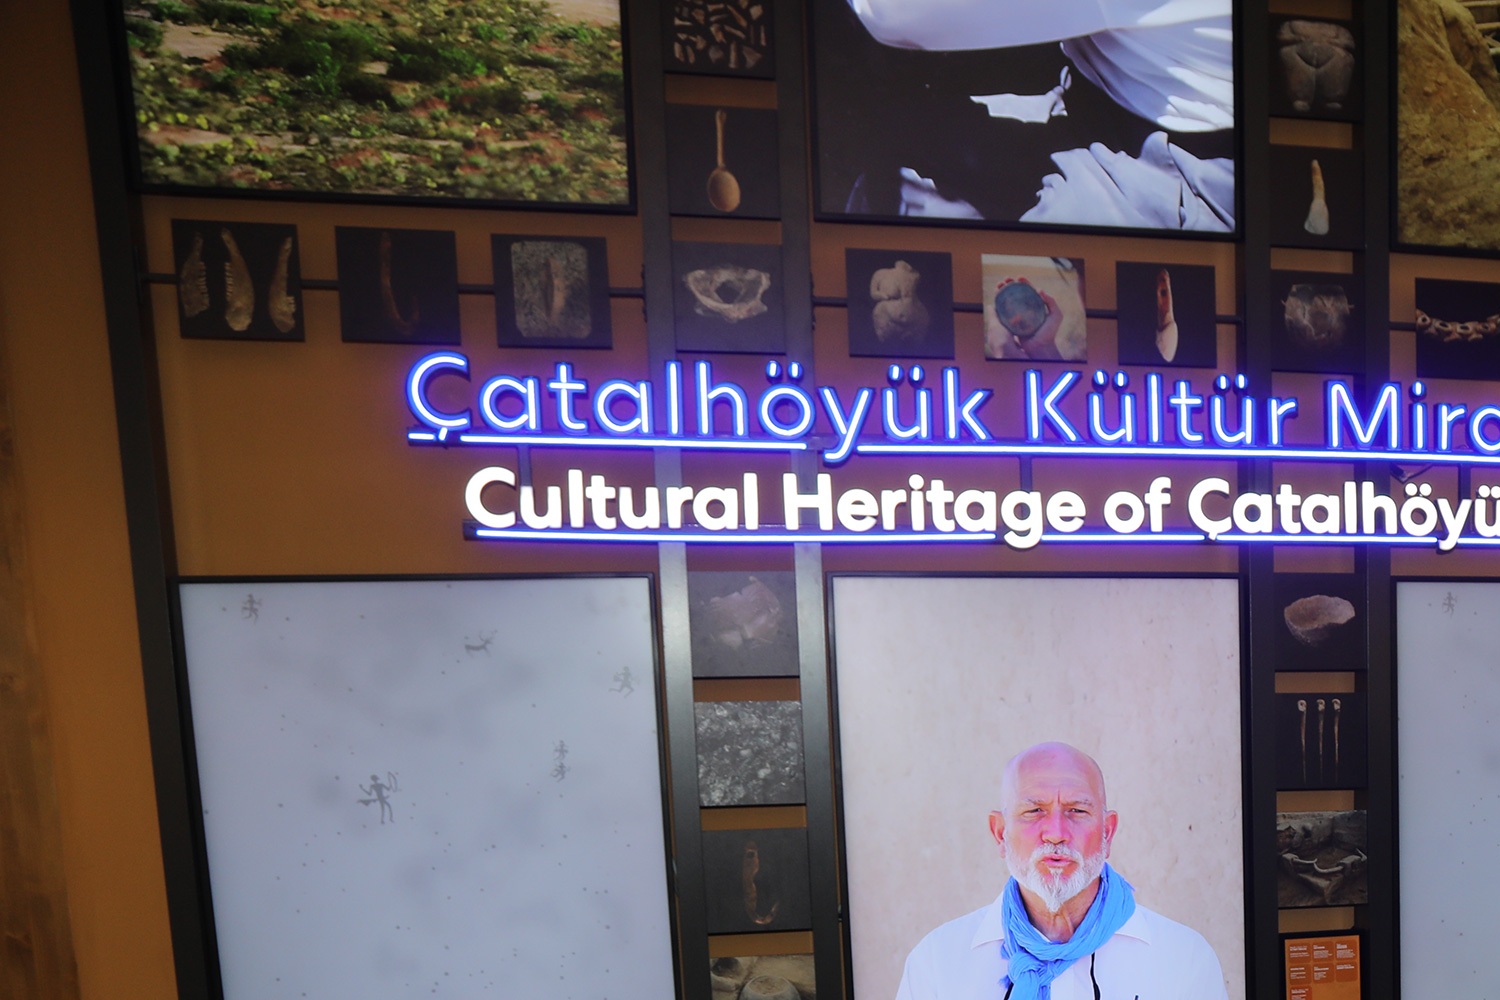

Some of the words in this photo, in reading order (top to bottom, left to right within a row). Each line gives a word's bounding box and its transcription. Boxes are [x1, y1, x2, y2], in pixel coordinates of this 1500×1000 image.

[406, 350, 994, 466] Çatalhöyük
[1025, 368, 1297, 446] Kültür
[464, 466, 759, 530] Cultural
[782, 472, 1087, 550] Heritage
[1103, 476, 1171, 533] of
